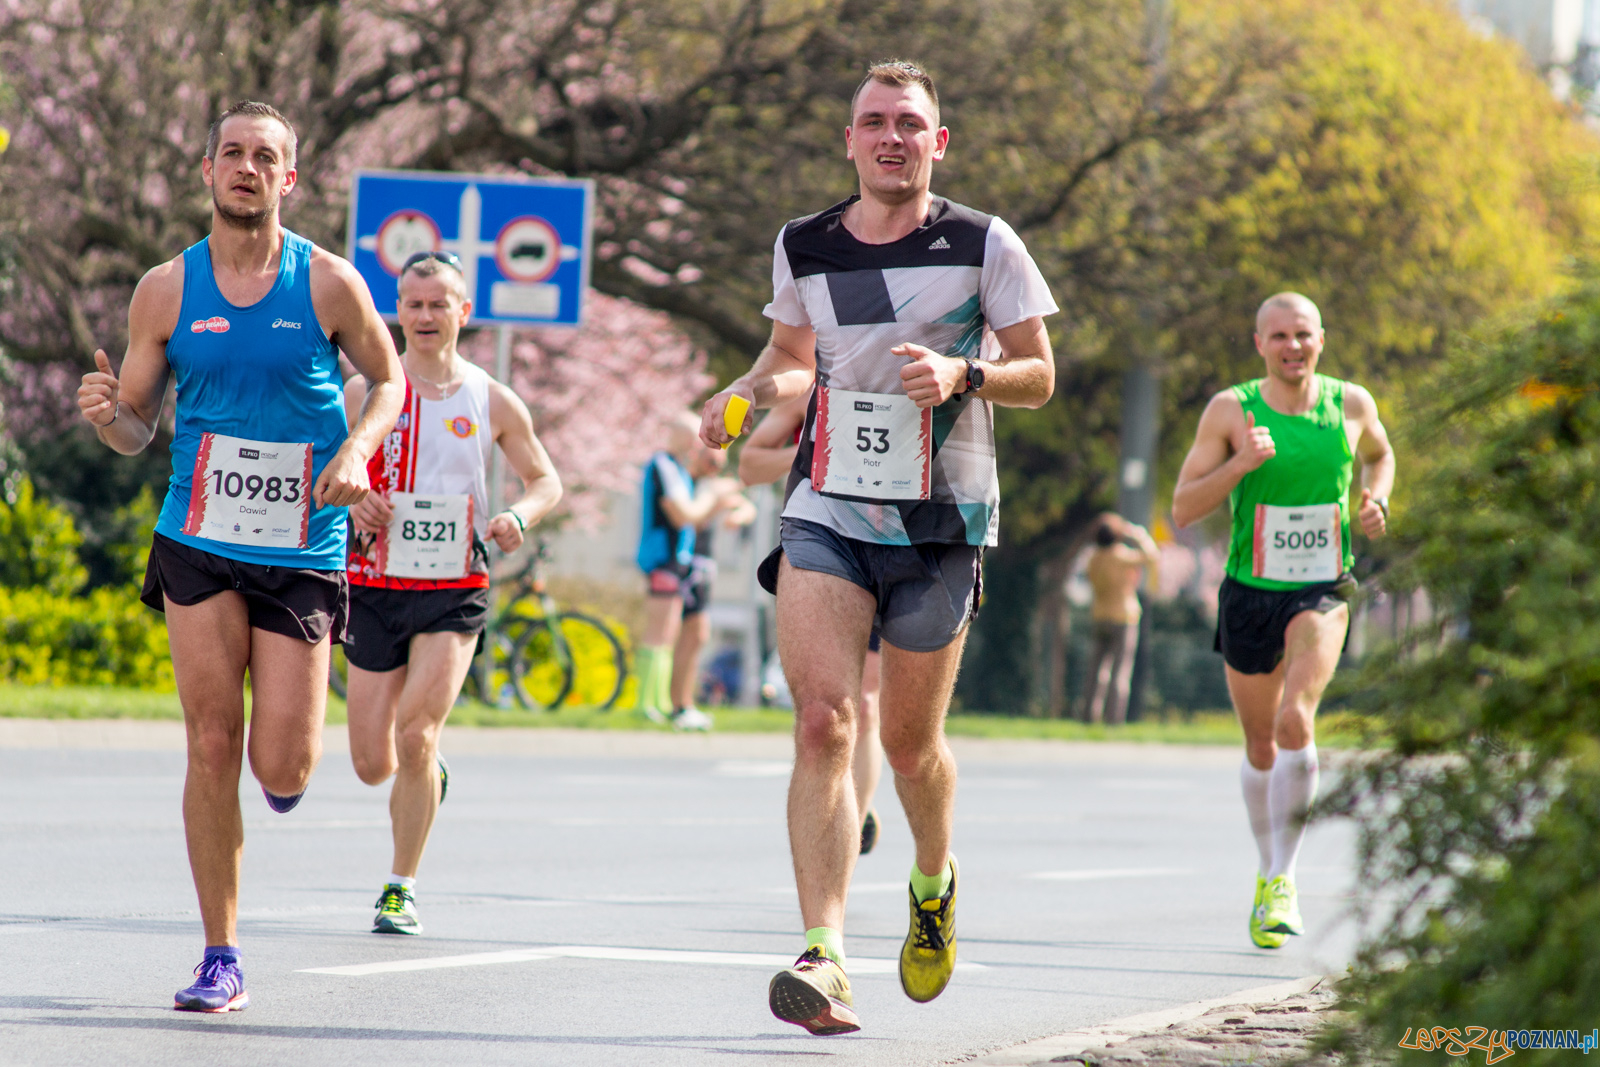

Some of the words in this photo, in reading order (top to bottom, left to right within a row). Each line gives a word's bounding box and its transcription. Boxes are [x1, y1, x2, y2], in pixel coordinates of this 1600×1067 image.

[856, 426, 890, 454] 53
[863, 458, 881, 467] Piotr
[212, 469, 300, 503] 10983
[239, 505, 267, 515] Dawid
[401, 520, 456, 541] 8321
[1273, 529, 1328, 549] 5005
